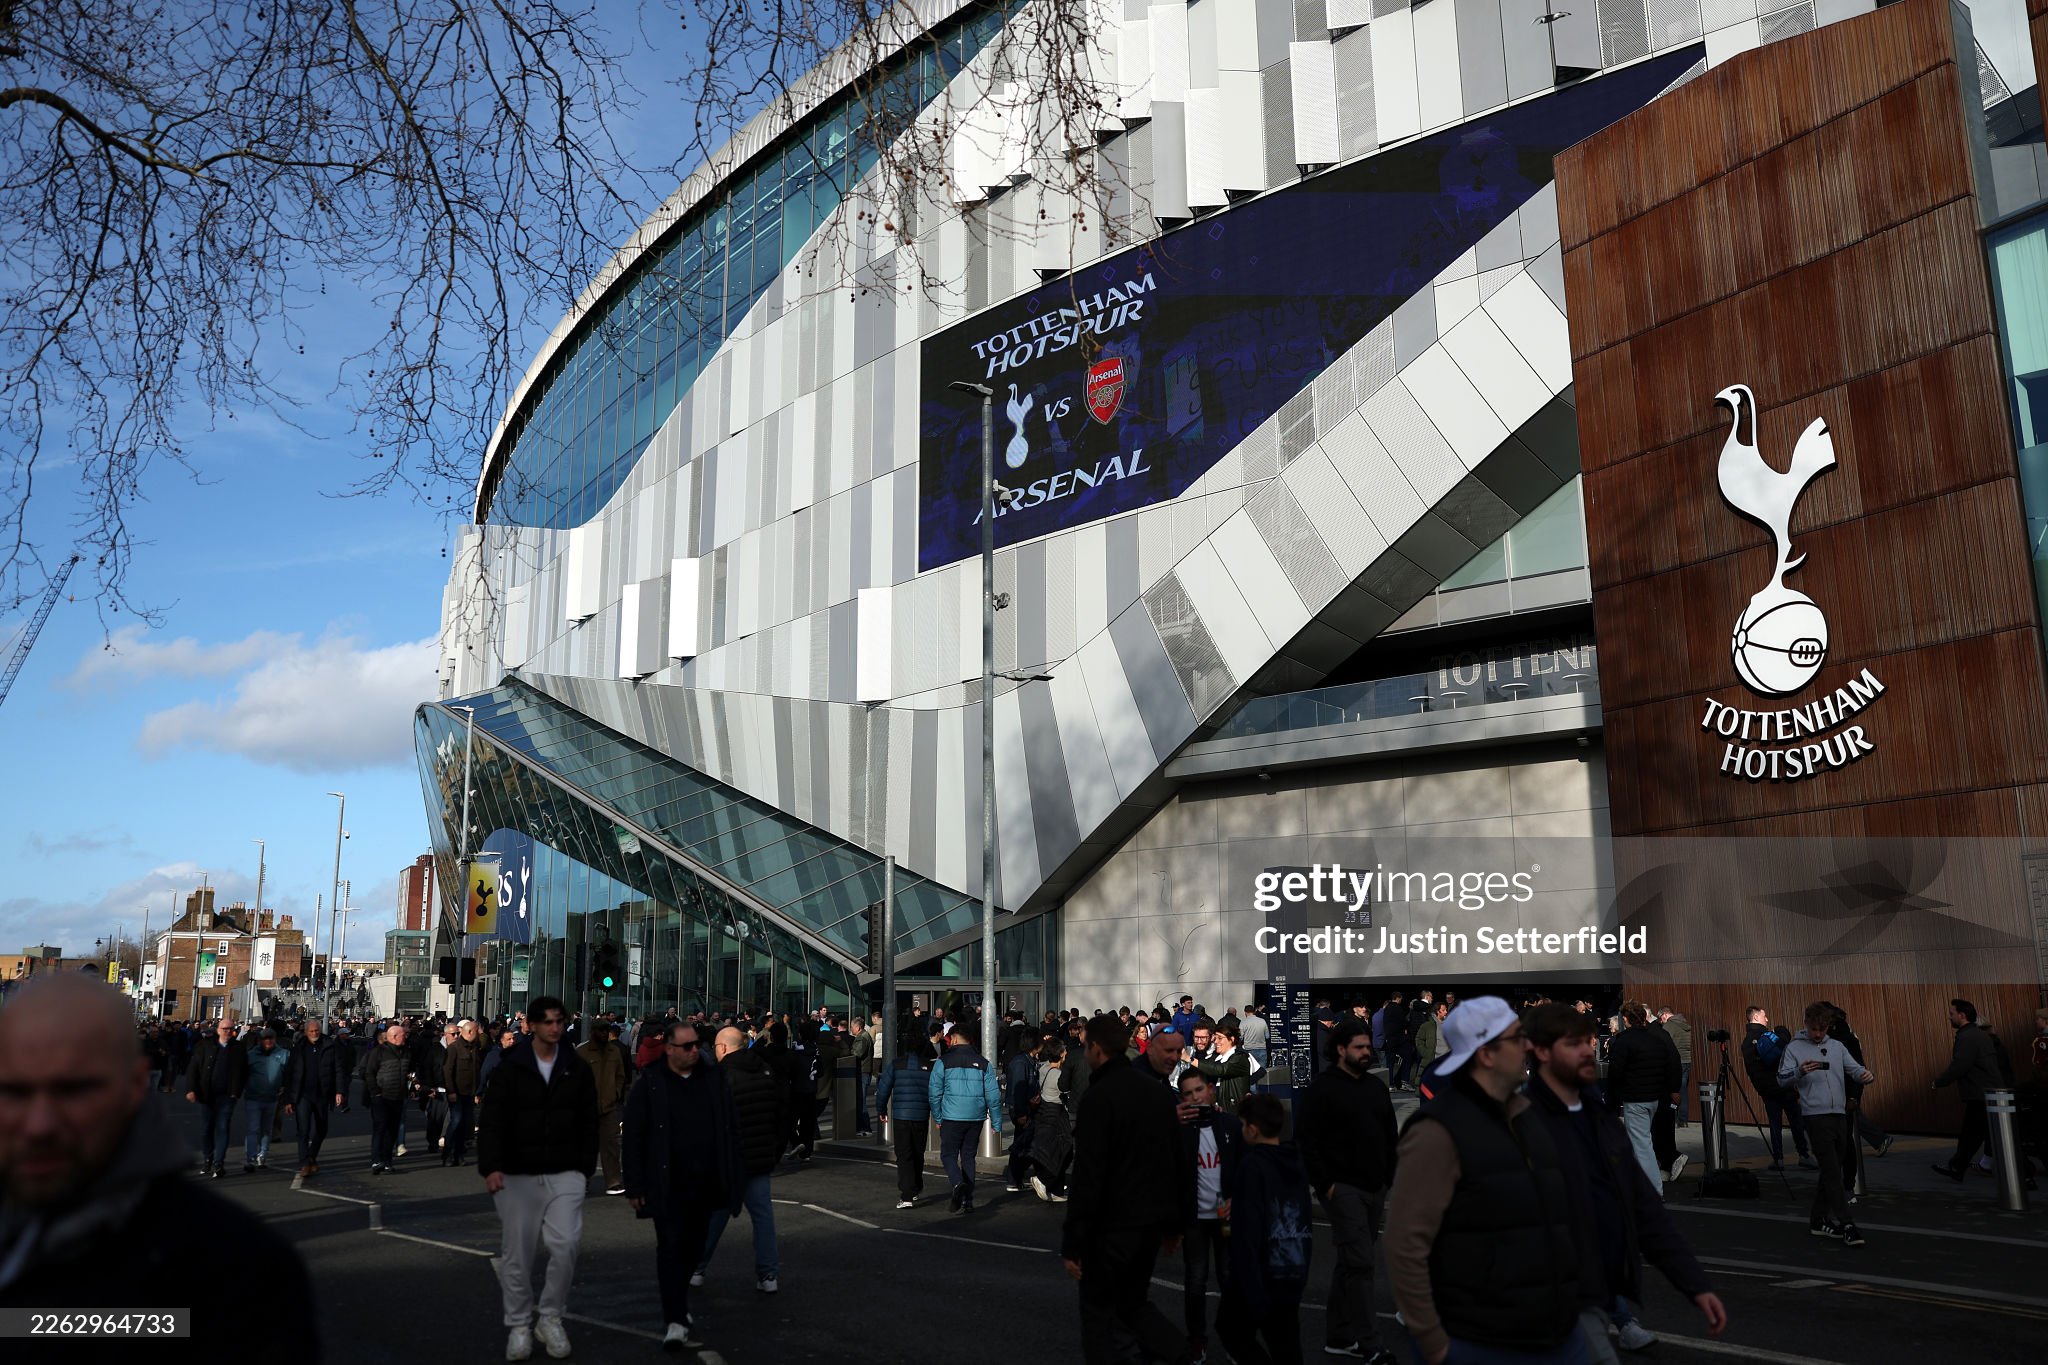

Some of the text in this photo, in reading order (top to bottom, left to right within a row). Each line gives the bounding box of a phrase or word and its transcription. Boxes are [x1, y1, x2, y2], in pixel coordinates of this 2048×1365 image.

[971, 272, 1157, 360] TOTTENHAM
[986, 299, 1144, 379] HOTSPUR
[1089, 365, 1122, 385] Arsenal
[1701, 667, 1886, 741] TOTTENHAM
[1720, 725, 1875, 779] HOTSPUR
